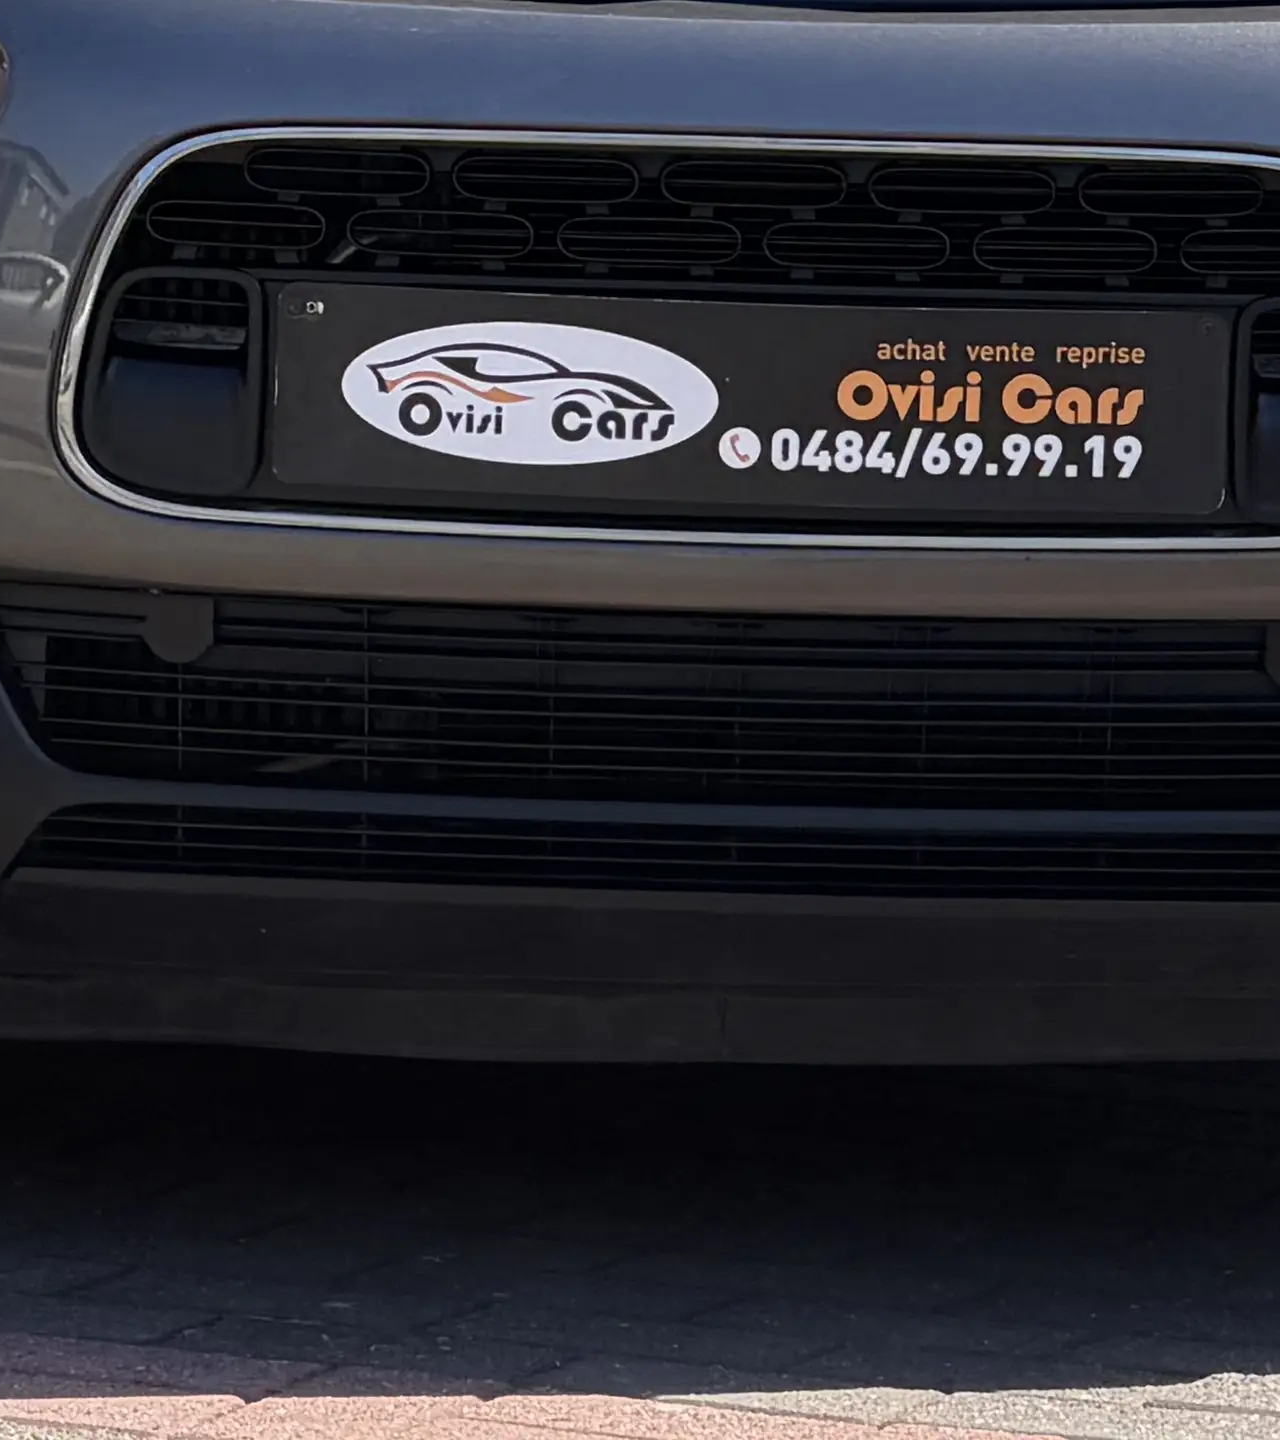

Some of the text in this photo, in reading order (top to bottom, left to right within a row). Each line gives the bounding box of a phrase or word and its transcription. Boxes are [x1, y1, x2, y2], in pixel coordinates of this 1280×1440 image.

[877, 338, 1146, 369] achat vente reprise
[398, 392, 675, 442] Ovisi Cars
[837, 369, 1145, 426] Ovisi Cars
[770, 427, 1143, 479] 0484/69.99.19
